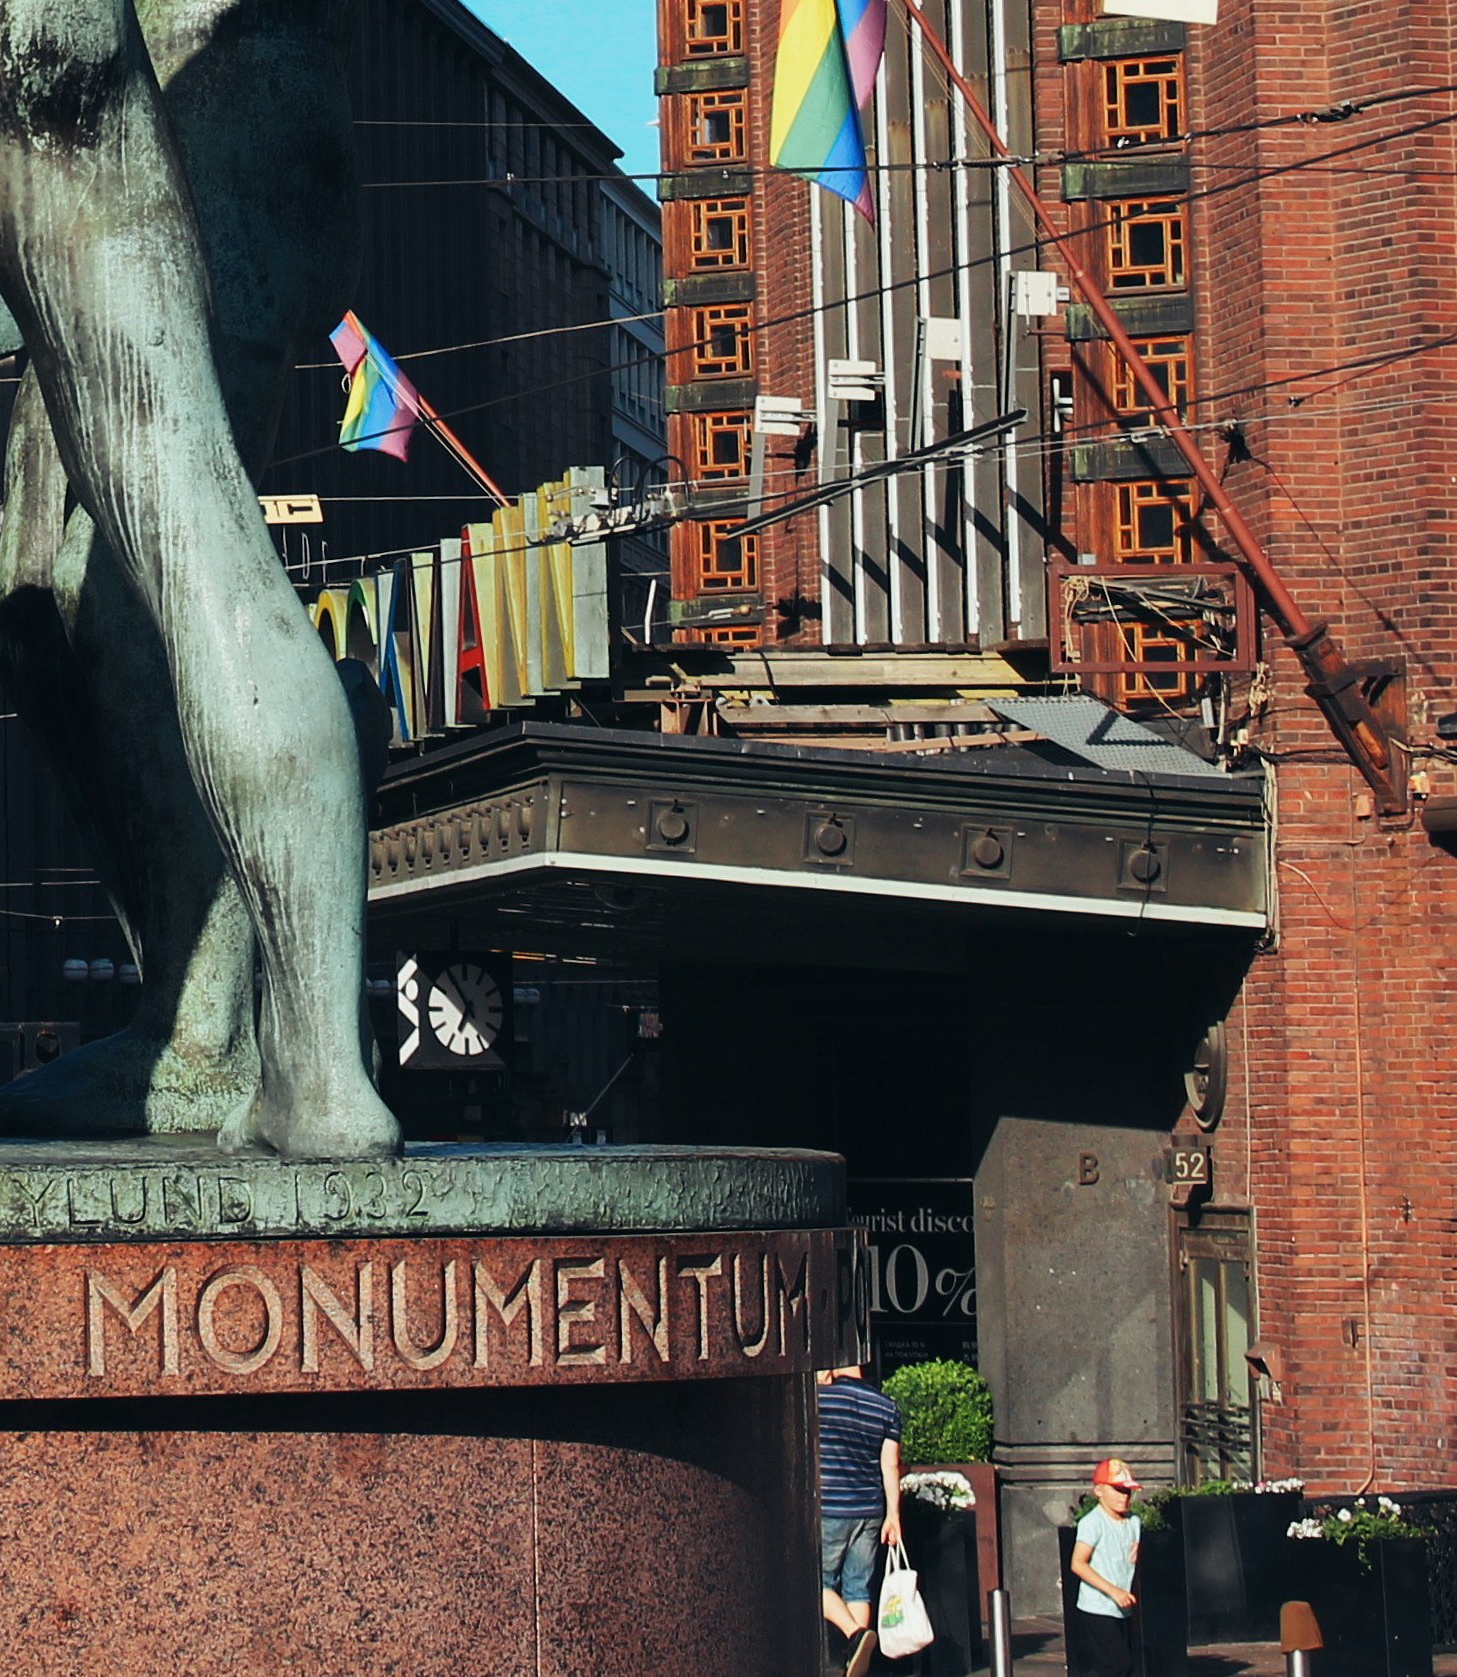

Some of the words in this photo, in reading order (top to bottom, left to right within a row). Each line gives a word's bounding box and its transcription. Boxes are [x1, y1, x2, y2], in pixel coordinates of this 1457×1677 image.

[1174, 1151, 1206, 1179] 52
[293, 1169, 430, 1226] 1932
[847, 1206, 907, 1233] ourist
[85, 1250, 812, 1378] MONUMENTUM
